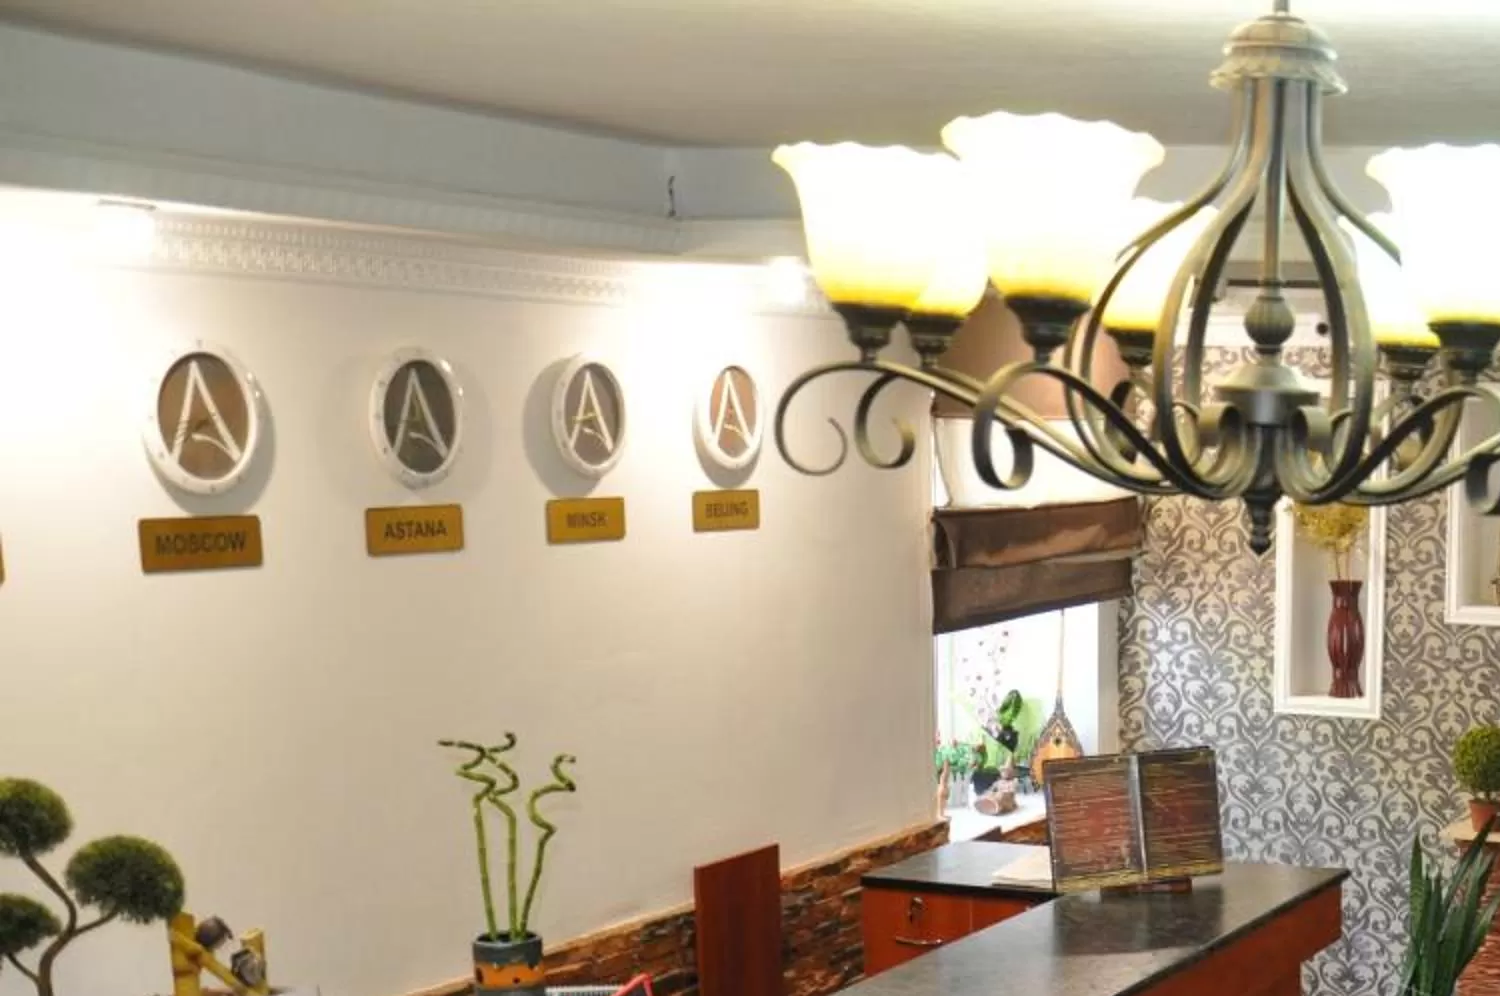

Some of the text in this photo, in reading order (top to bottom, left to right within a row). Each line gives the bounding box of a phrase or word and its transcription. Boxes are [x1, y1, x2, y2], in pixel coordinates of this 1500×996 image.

[384, 519, 448, 540] ASTANA
[566, 511, 608, 529] MINSK
[155, 531, 246, 555] MOSCOW
